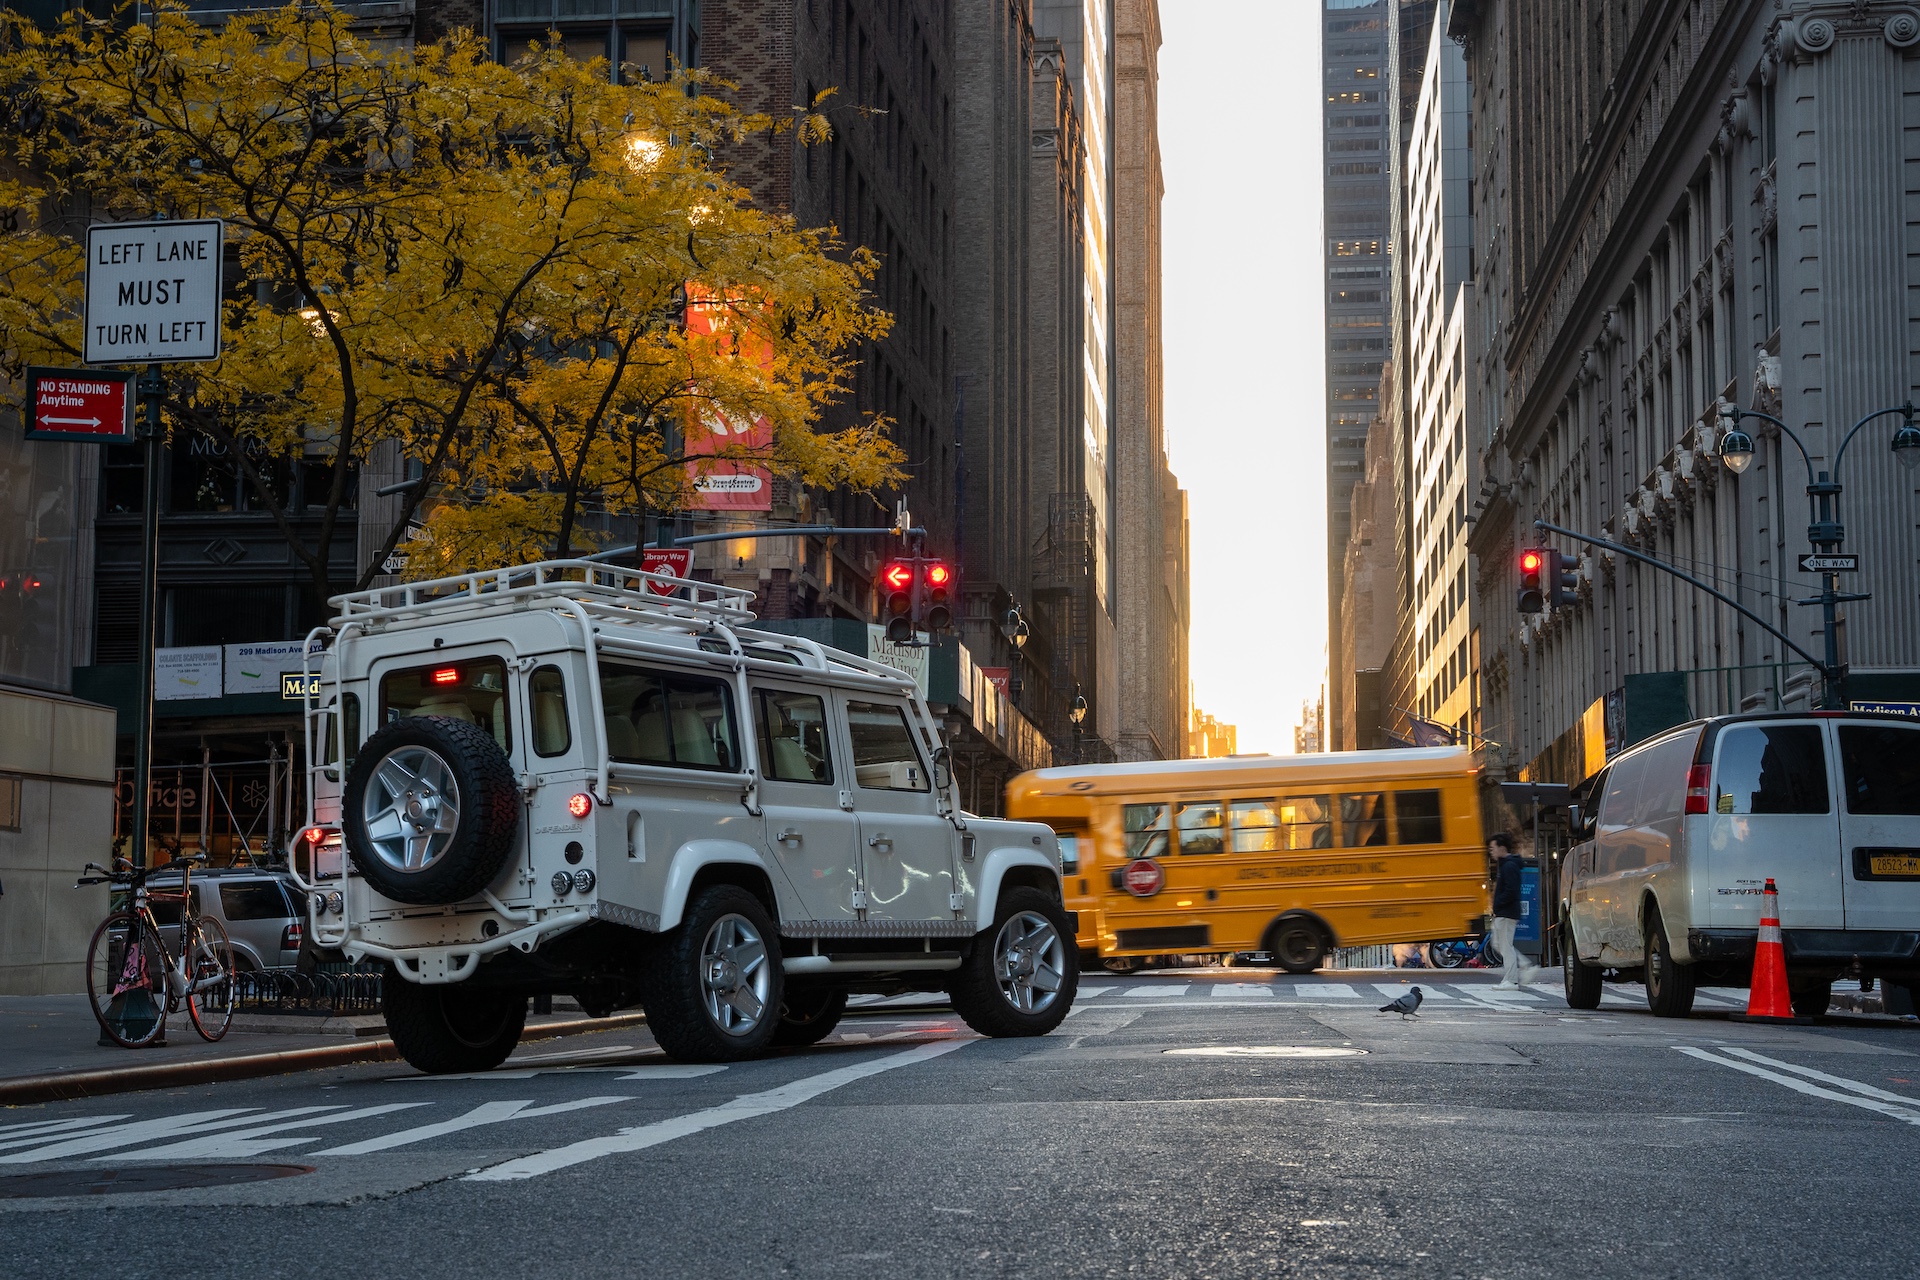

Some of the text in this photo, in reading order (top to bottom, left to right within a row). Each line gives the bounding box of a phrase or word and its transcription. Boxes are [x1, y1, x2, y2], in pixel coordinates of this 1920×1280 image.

[99, 240, 208, 265] LEFT LANE
[118, 279, 185, 307] MUST
[97, 321, 206, 346] TURN LEFT
[41, 381, 111, 395] NO STANDING
[40, 394, 84, 407] Anytime
[644, 553, 686, 562] Library Way
[1809, 559, 1851, 567] ONE WAY
[239, 648, 253, 656] 299
[255, 646, 287, 655] Madison
[535, 823, 583, 834] DEFENDER
[1126, 871, 1159, 885] STOP
